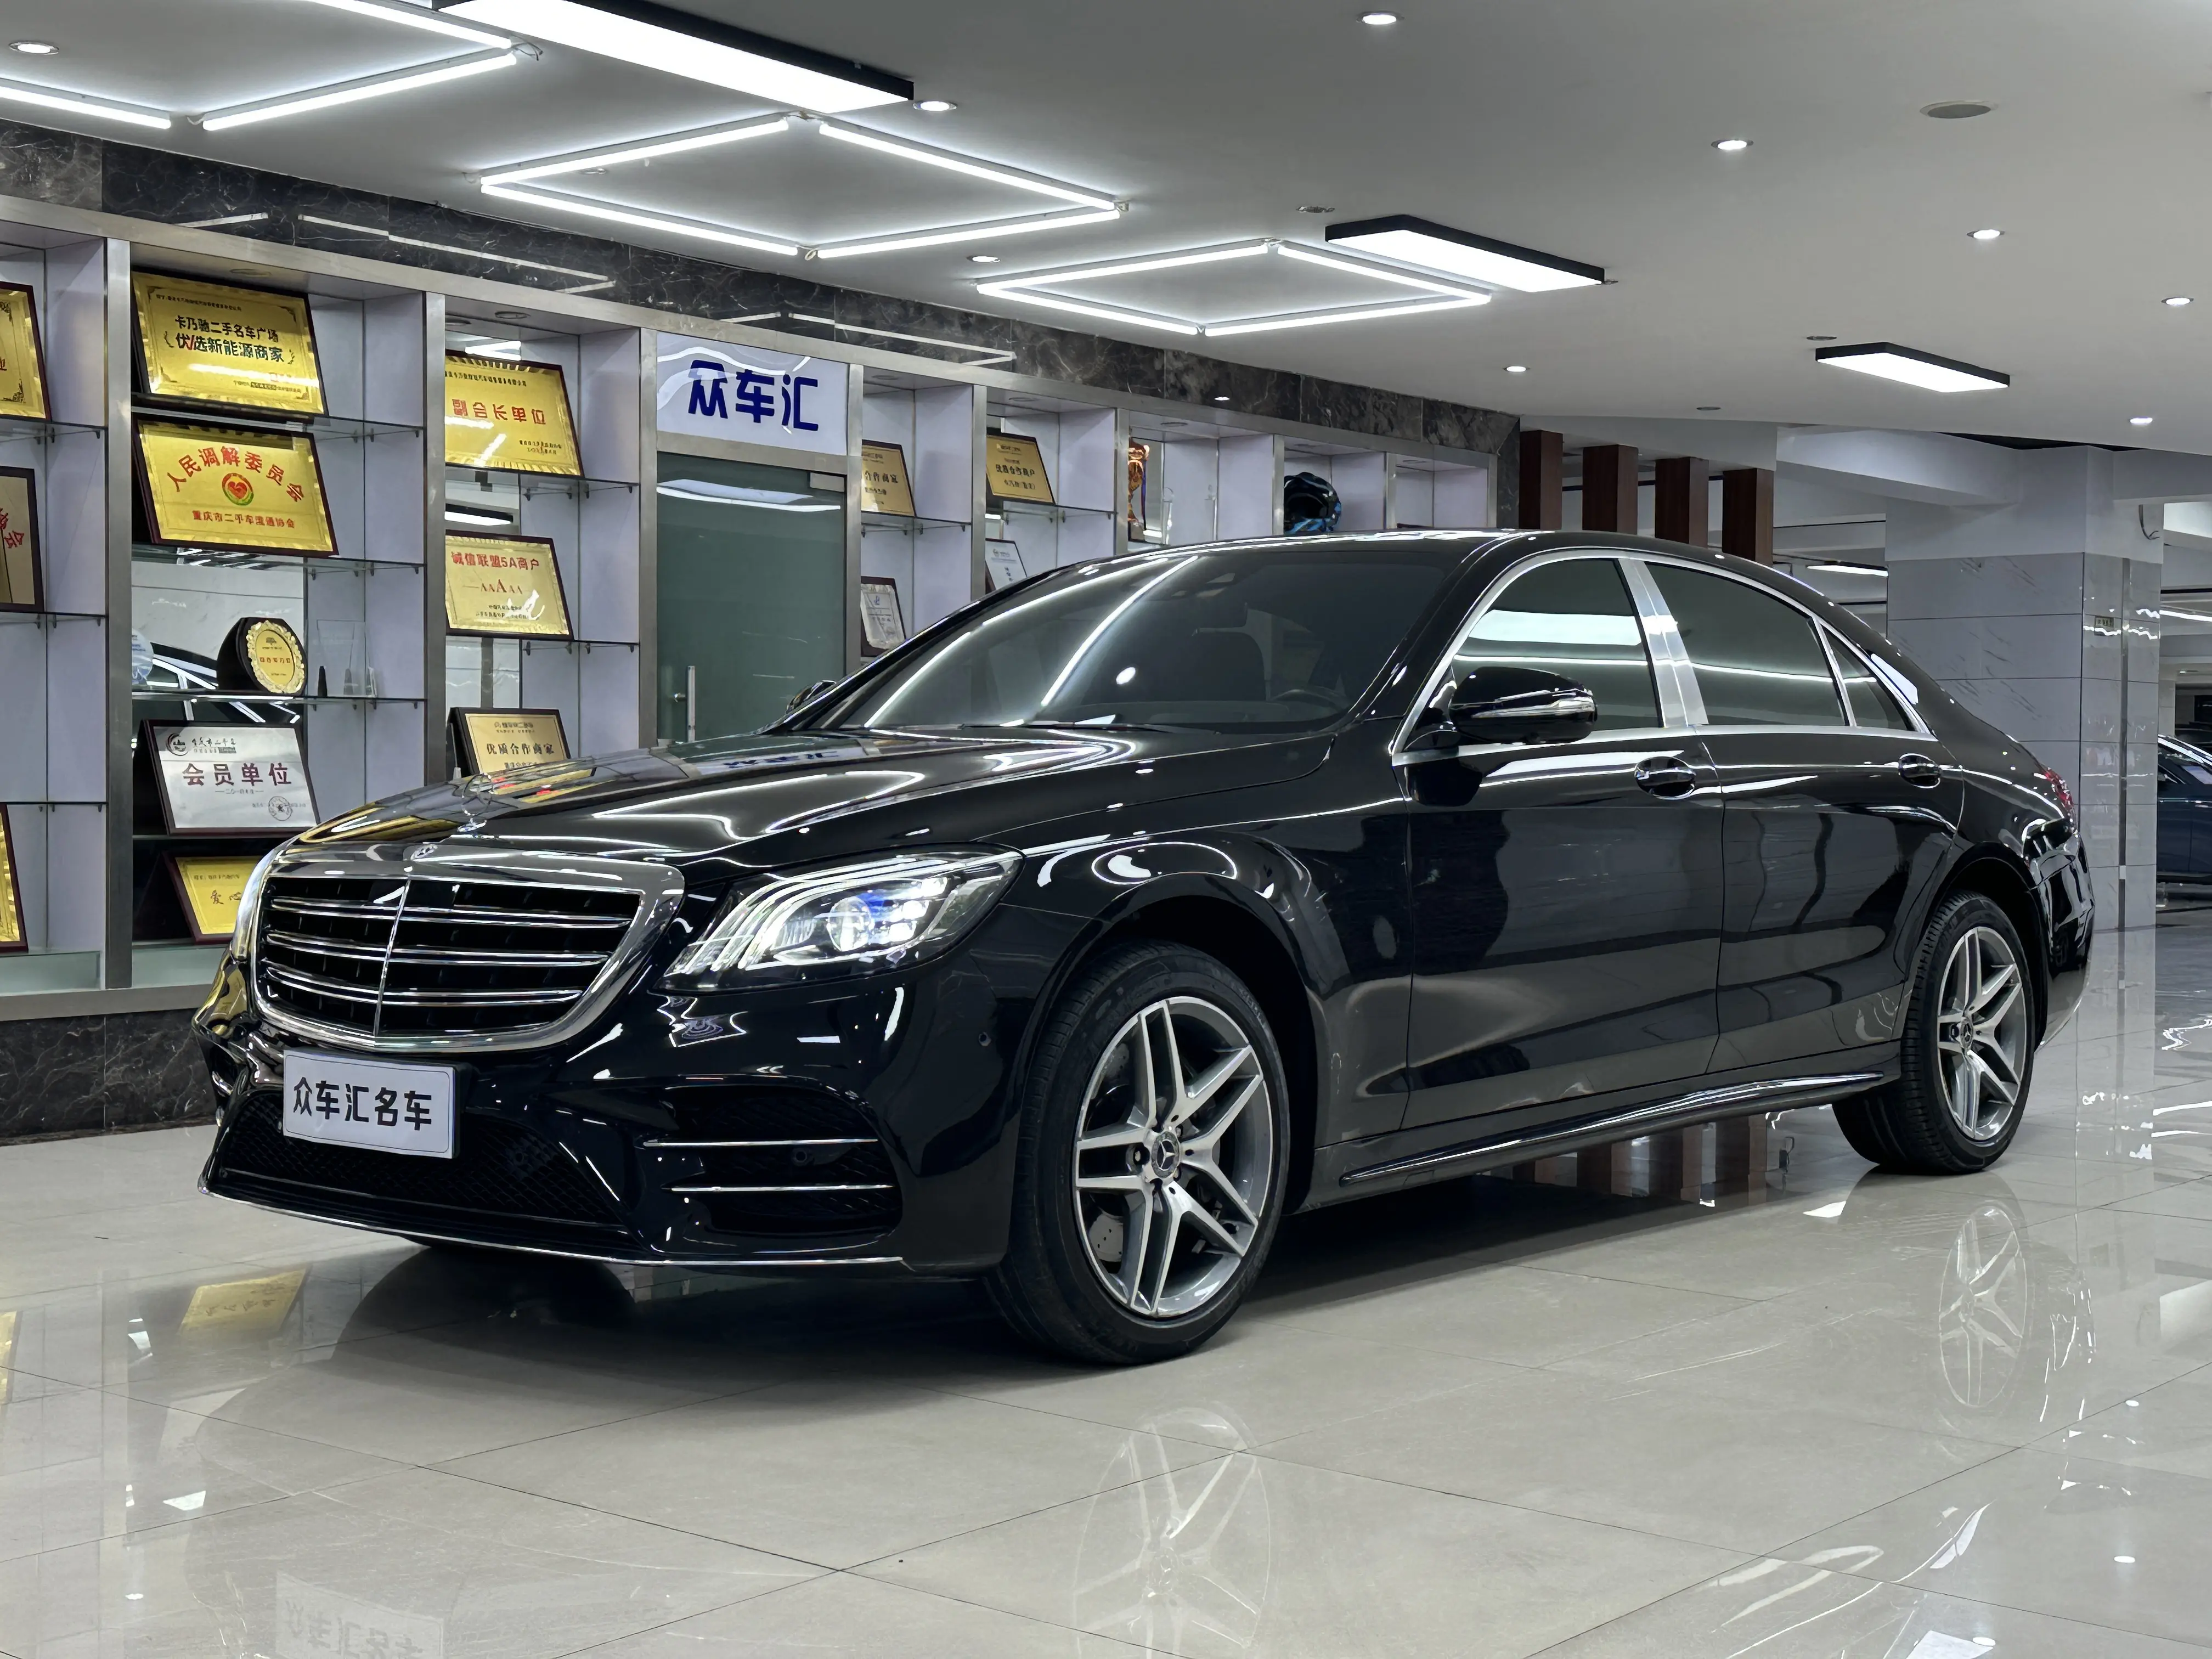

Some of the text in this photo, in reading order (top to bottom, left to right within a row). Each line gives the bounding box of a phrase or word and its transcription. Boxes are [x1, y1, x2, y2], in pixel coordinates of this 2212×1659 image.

[452, 399, 546, 425] 副会长单位
[688, 359, 819, 431] 众车汇
[167, 446, 304, 502] 人民调解委员会
[182, 763, 291, 786] 会员单位
[294, 1077, 432, 1131] 众车汇名车
